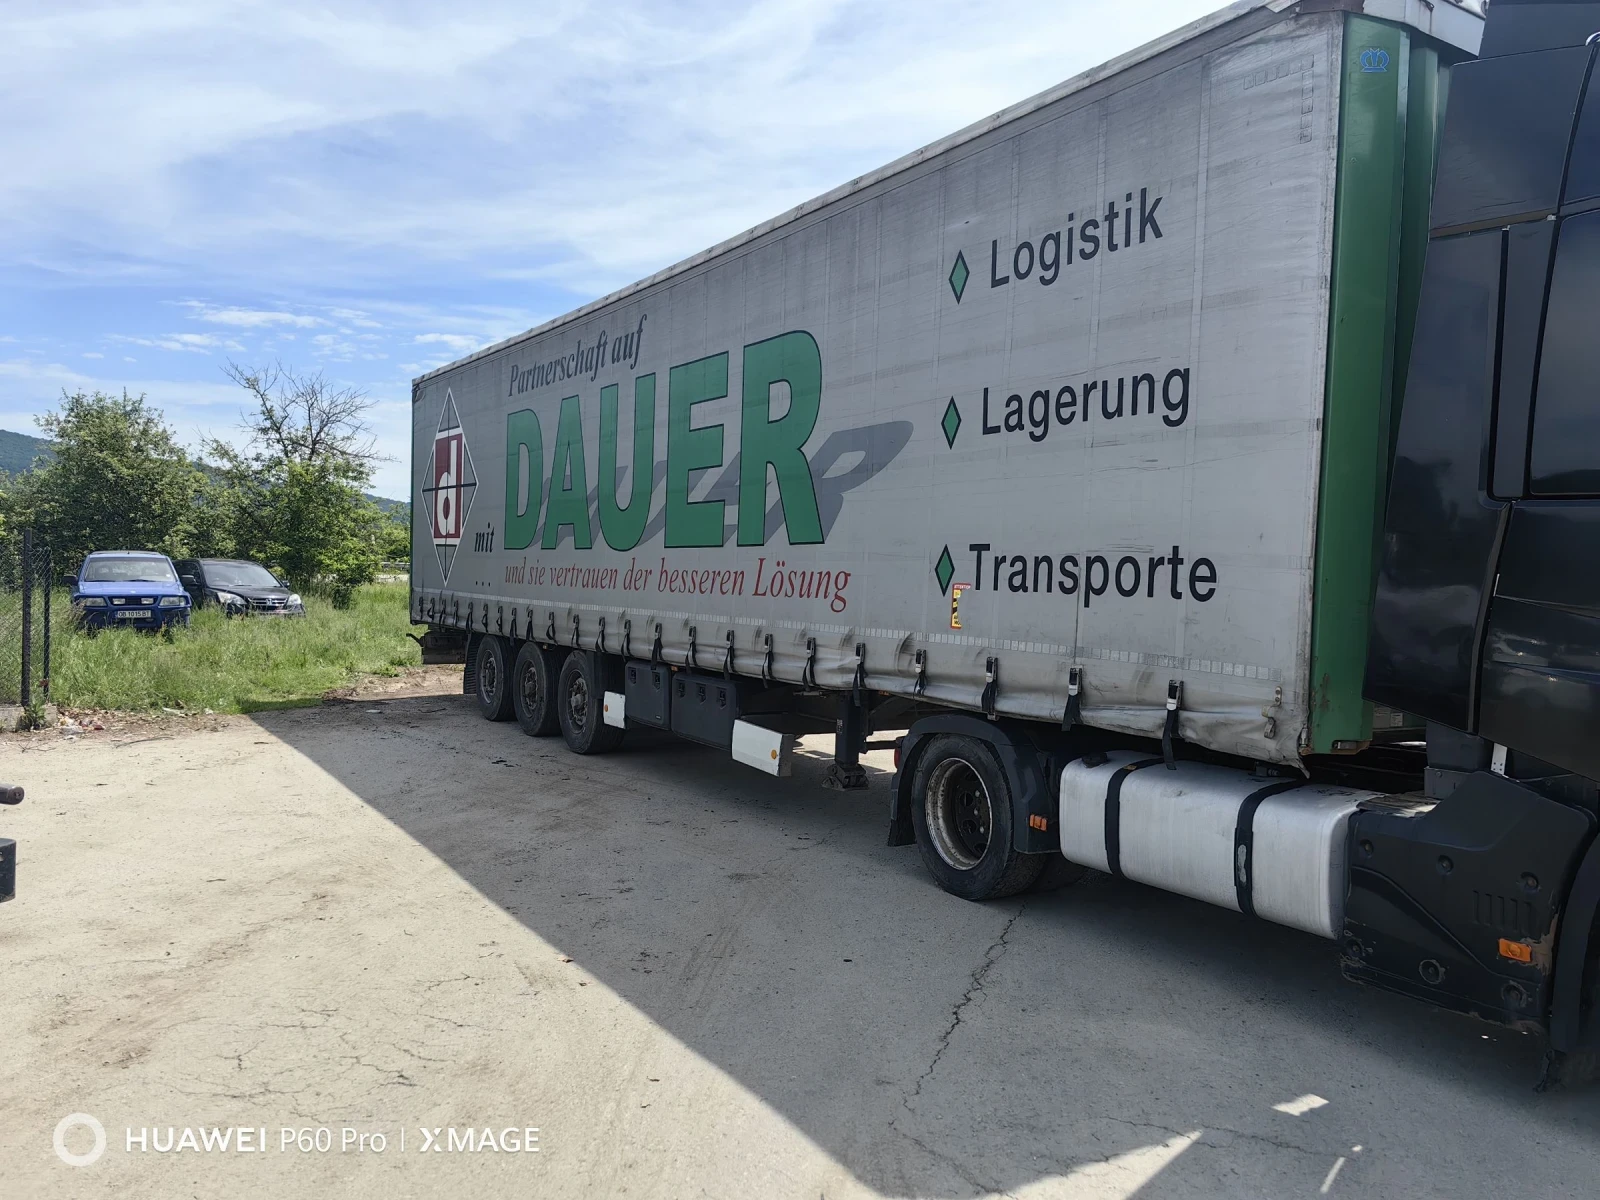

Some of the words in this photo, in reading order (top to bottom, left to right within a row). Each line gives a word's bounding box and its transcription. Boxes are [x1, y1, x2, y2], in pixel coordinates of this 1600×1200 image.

[990, 187, 1164, 289] Logistik
[508, 331, 607, 397] Partnerschaft
[611, 314, 647, 369] auf
[474, 522, 495, 553] mit
[504, 329, 825, 551] DAUER
[981, 367, 1191, 442] Lagerung
[505, 556, 527, 585] und
[529, 557, 546, 585] sie
[549, 562, 618, 591] vertrauen
[623, 557, 652, 592] der
[658, 557, 745, 596] besseren
[752, 557, 852, 613] Lösung
[969, 543, 1218, 608] Transporte
